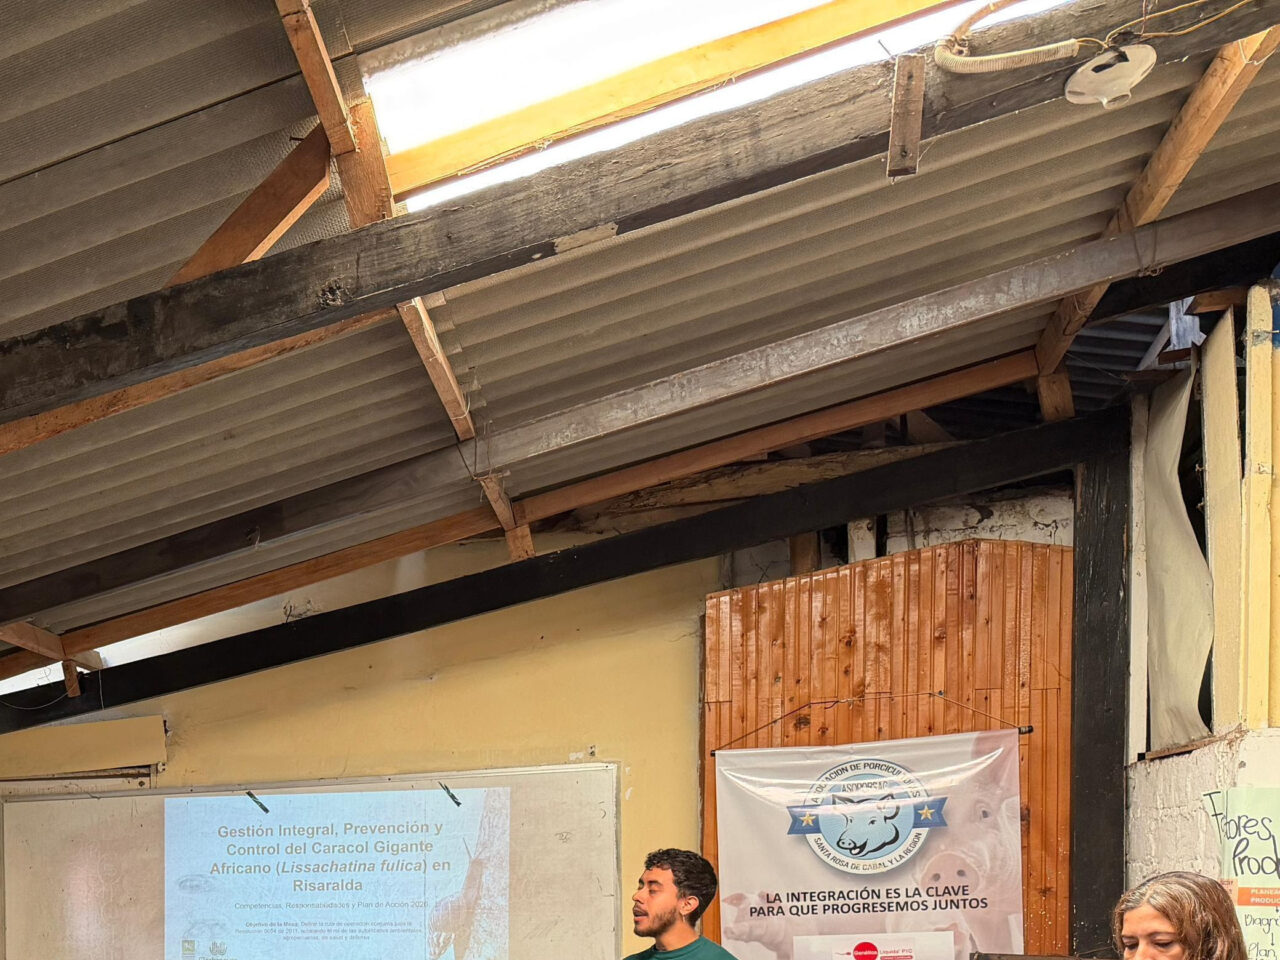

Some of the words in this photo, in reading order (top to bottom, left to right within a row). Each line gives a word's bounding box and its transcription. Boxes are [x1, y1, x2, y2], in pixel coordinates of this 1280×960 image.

[849, 762, 861, 771] DE
[217, 822, 274, 838] Gestión
[278, 823, 339, 839] Integral,
[343, 820, 430, 835] Prevención
[434, 822, 443, 836] y
[226, 842, 280, 856] Control
[284, 842, 307, 855] del
[311, 841, 369, 855] Caracol
[373, 840, 434, 856] Gigante
[814, 837, 833, 859] SANTA
[830, 856, 849, 870] ROSA
[850, 862, 861, 870] DE
[894, 854, 906, 863] LA
[903, 832, 923, 856] REGION
[210, 862, 272, 875] Africano
[276, 860, 376, 876] (Lissachatina
[380, 859, 428, 874] fulica)
[432, 861, 451, 871] en
[293, 878, 363, 892] Risaralda
[766, 893, 783, 904] LA
[786, 887, 881, 903] INTEGRACIÓN
[885, 888, 901, 899] ES
[905, 887, 922, 898] LA
[925, 885, 970, 898] CLAVE
[749, 905, 785, 918] PARA
[789, 903, 818, 917] QUE
[822, 900, 929, 915] PROGRESEMOS
[932, 897, 988, 912] JUNTOS
